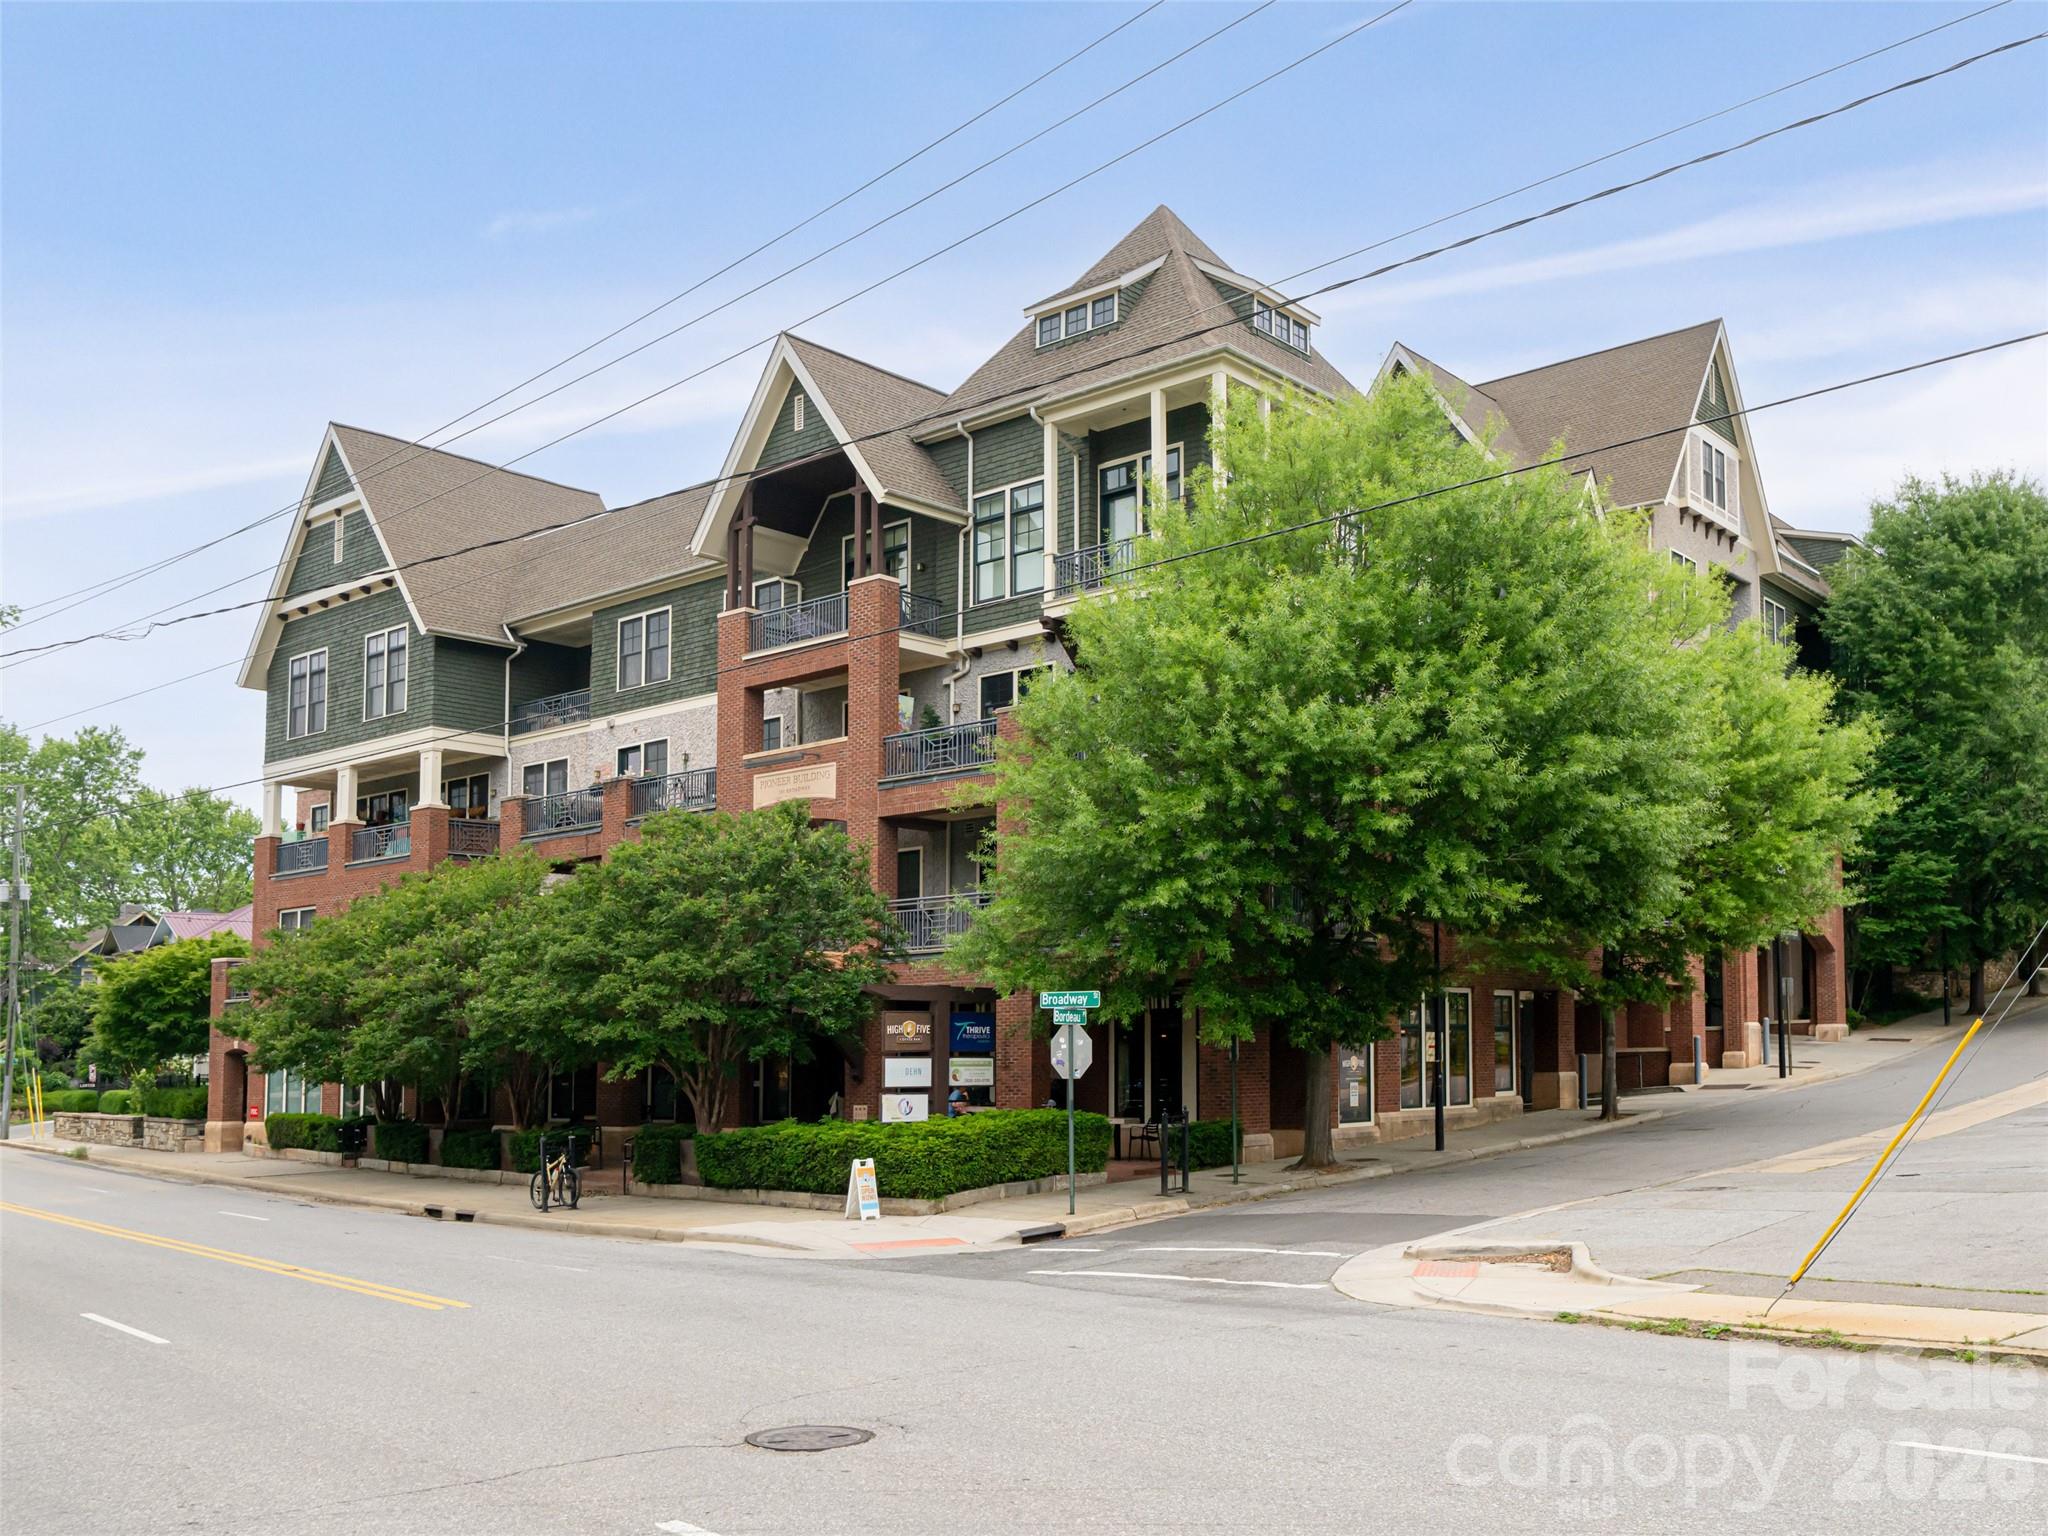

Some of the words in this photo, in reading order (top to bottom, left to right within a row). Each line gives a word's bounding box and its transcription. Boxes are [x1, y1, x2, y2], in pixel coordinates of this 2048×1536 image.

[760, 776, 791, 790] PIONEER
[793, 769, 831, 784] BUILDING
[1042, 993, 1088, 1006] Broadway
[1055, 1010, 1081, 1022] Bordeau
[887, 1024, 904, 1034] HIGH
[916, 1024, 931, 1034] FIVE
[966, 1026, 990, 1034] THRIVE
